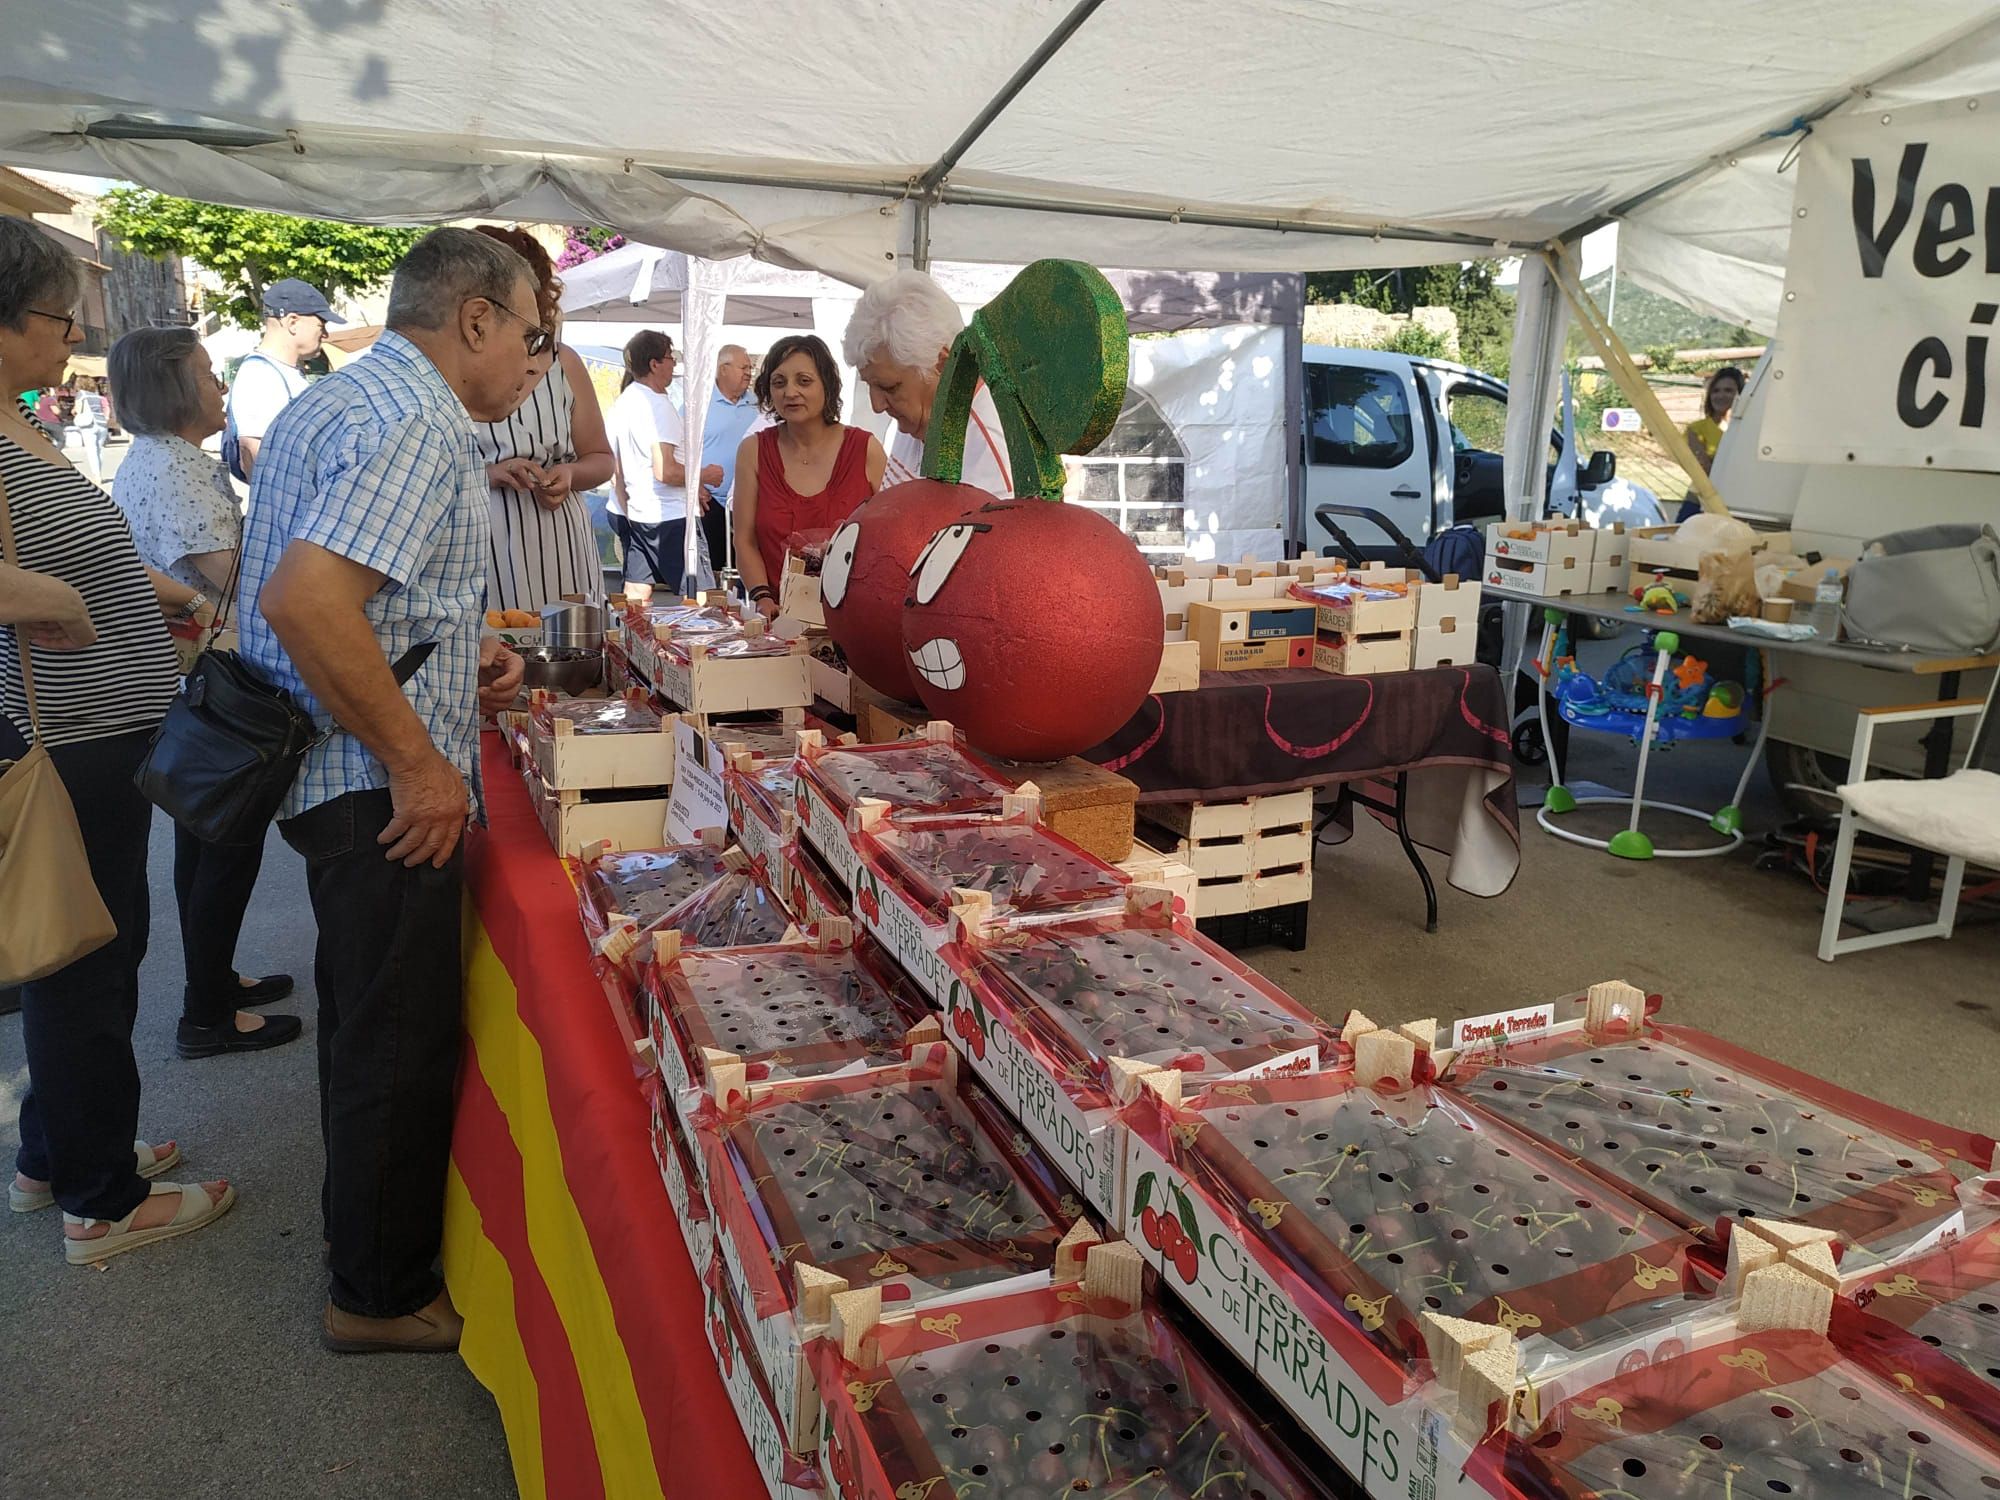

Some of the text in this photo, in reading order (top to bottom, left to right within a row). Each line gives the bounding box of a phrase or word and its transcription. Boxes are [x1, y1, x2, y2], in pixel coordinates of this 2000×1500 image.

[1851, 142, 2000, 278] Ve
[1224, 648, 1264, 656] STANDARD
[881, 889, 923, 942] Cirera
[892, 916, 946, 994] TERRADES
[990, 1018, 1057, 1103] Cirera
[1491, 1018, 1505, 1036] de
[1506, 1011, 1547, 1034] Terrades
[998, 1061, 1009, 1086] DE
[1007, 1056, 1095, 1181] TERRADES
[1208, 1232, 1330, 1363] Cirera
[1222, 1287, 1241, 1325] DE
[1240, 1284, 1399, 1483] TERRADES
